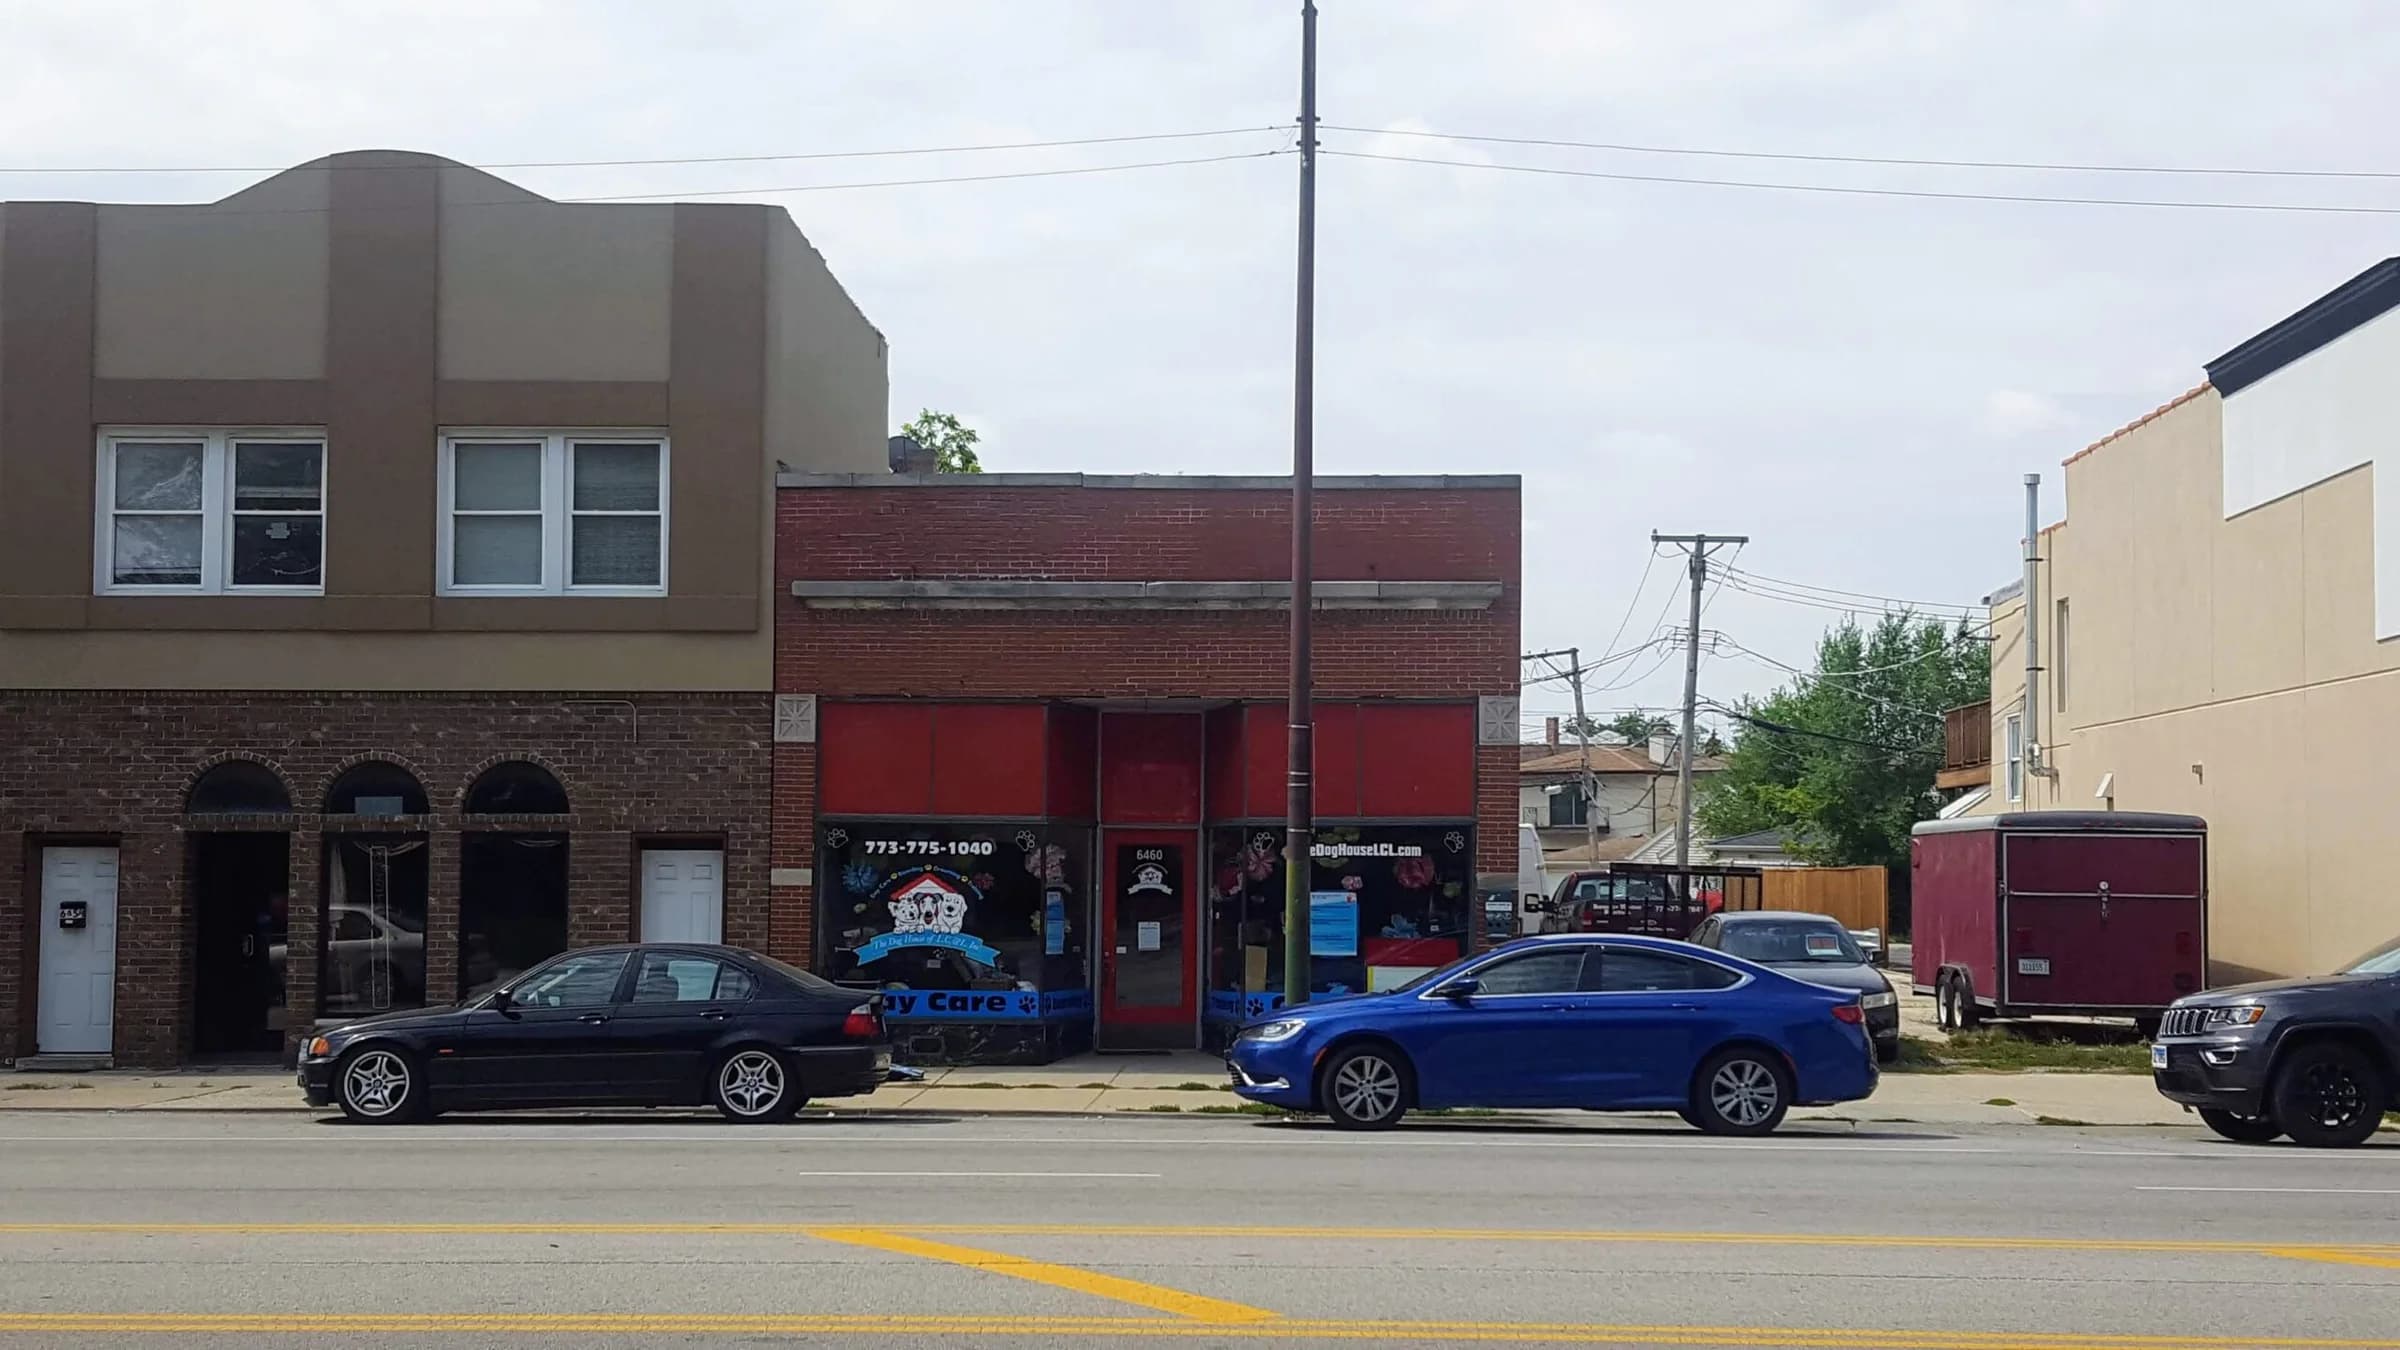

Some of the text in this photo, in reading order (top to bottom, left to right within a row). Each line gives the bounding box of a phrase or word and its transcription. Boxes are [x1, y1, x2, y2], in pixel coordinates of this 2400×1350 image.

[865, 841, 993, 855] 773-775-1040
[1136, 849, 1163, 860] 6460
[1309, 843, 1422, 858] eDogHouseLCL.com
[888, 937, 903, 946] Dog
[884, 993, 1006, 1014] ay Care
